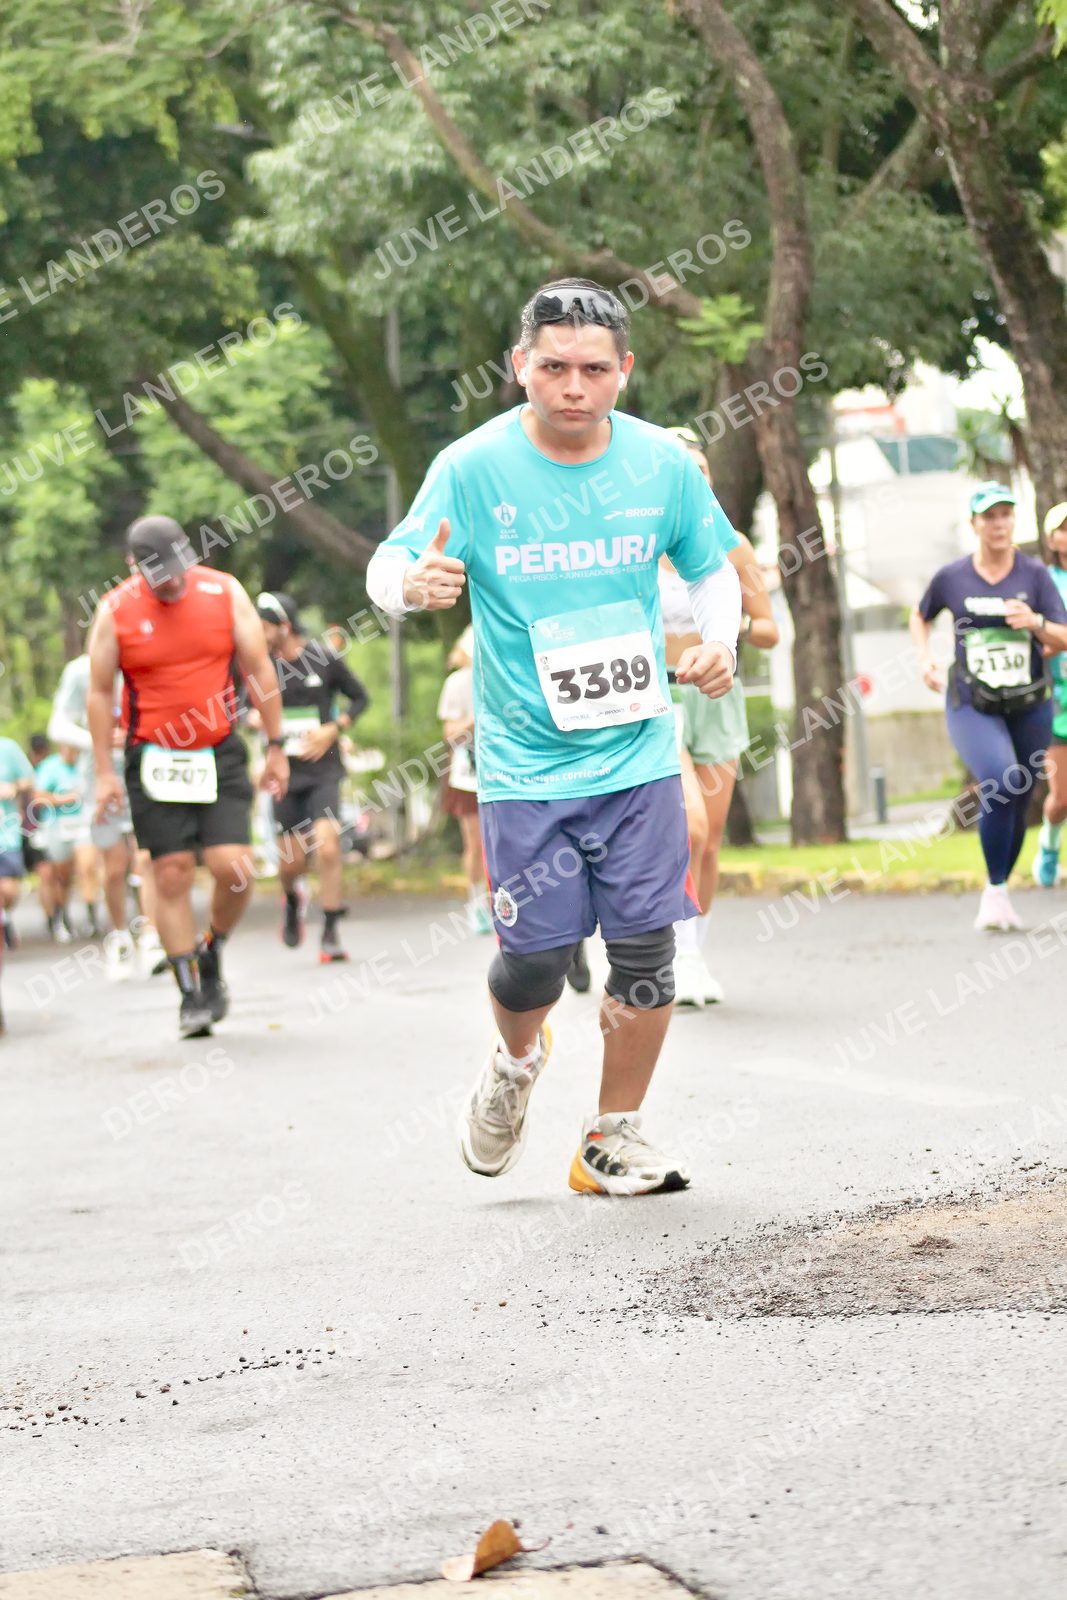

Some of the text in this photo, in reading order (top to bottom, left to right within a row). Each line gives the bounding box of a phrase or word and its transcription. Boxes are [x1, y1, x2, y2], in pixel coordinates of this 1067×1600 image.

[625, 507, 665, 518] BROOKS
[509, 575, 531, 583] PEGA
[533, 572, 558, 582] PISOS
[974, 653, 1025, 673] 2130
[550, 654, 651, 704] 3389
